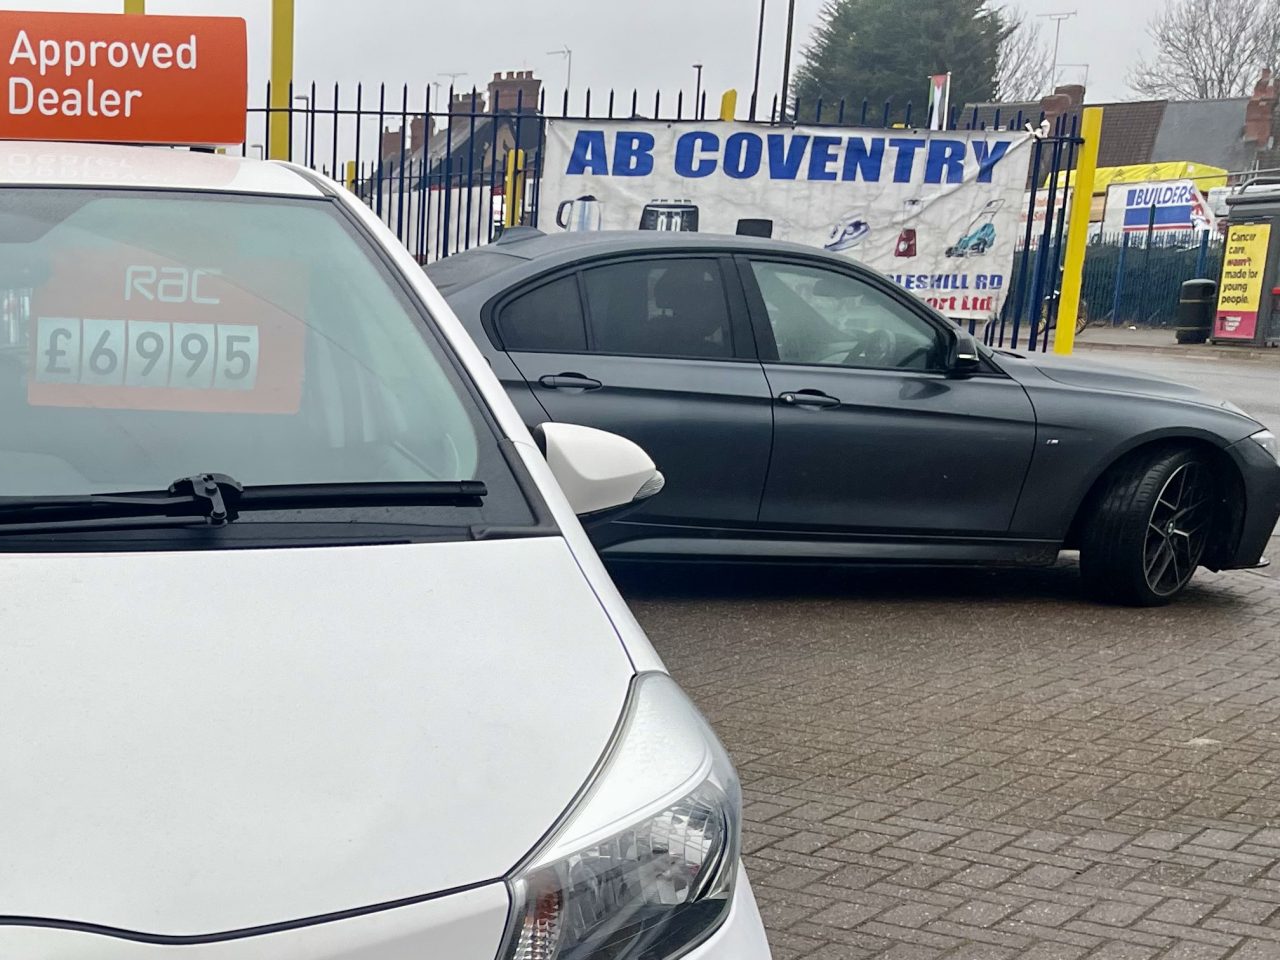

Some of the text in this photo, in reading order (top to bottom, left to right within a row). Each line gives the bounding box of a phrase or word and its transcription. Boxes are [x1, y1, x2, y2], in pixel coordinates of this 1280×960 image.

[9, 30, 198, 76] Approved
[9, 77, 143, 117] Dealer
[566, 130, 1012, 184] AB COVENTRY
[1135, 186, 1194, 206] BUILDERS
[975, 274, 1003, 290] RD
[1224, 269, 1258, 279] made for
[1223, 283, 1248, 293] young
[961, 296, 993, 311] Ltd
